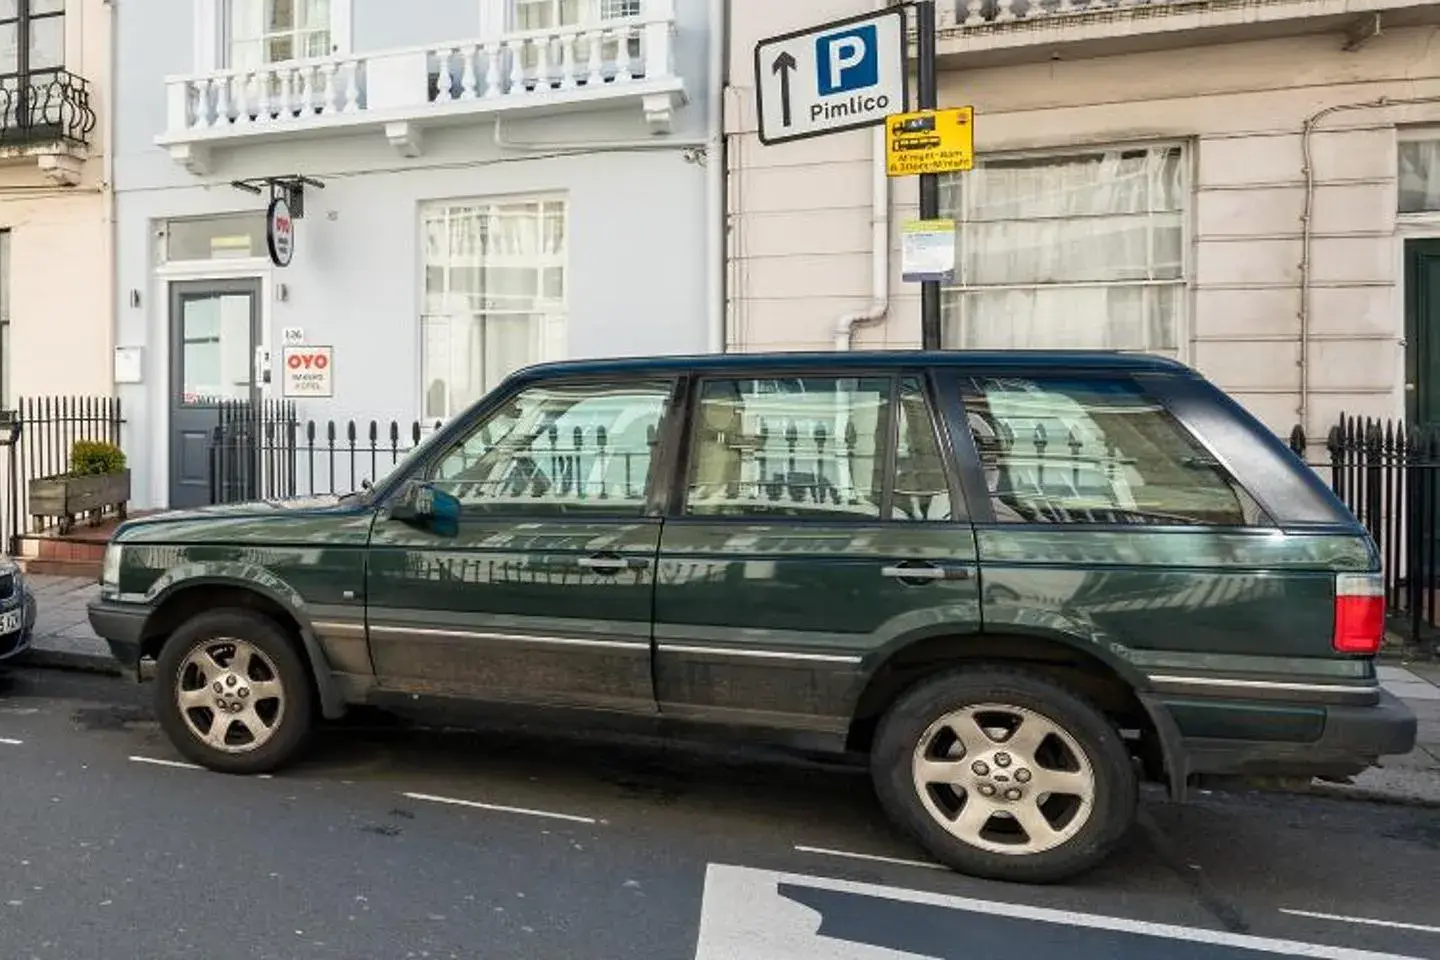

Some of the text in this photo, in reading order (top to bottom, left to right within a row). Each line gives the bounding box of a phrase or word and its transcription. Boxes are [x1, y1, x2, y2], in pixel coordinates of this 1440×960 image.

[829, 36, 866, 88] P
[810, 95, 889, 121] Pimlico
[287, 354, 328, 369] OYO
